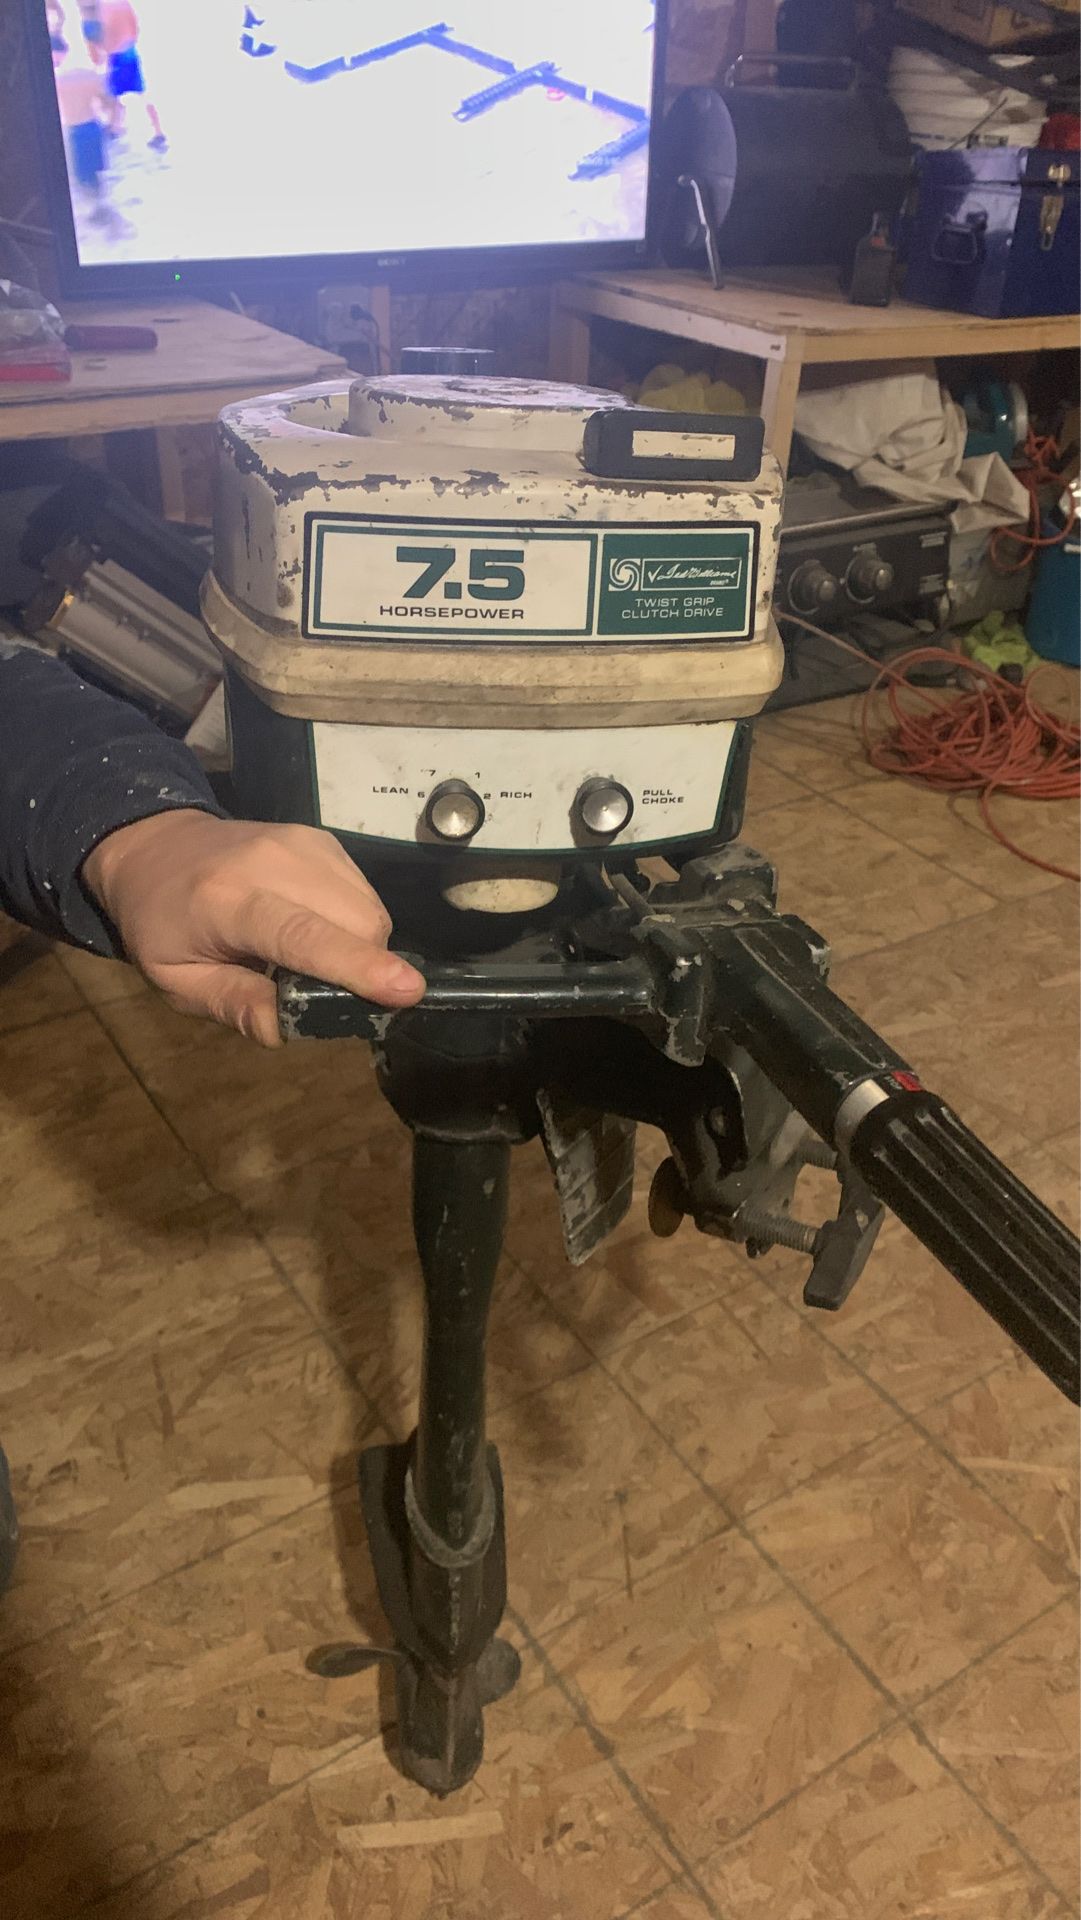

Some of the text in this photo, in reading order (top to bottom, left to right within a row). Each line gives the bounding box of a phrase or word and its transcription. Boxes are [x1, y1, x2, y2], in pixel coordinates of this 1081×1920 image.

[396, 546, 525, 601] 7.5
[635, 597, 715, 608] TWIST GRIP
[379, 605, 524, 620] HORSEPOWER
[621, 607, 724, 619] CLUTCH DRIVE
[372, 786, 409, 794] LEAN
[642, 789, 673, 797] PULL
[417, 791, 426, 799] 6
[500, 791, 532, 799] RICH
[641, 796, 685, 805] CHOKE
